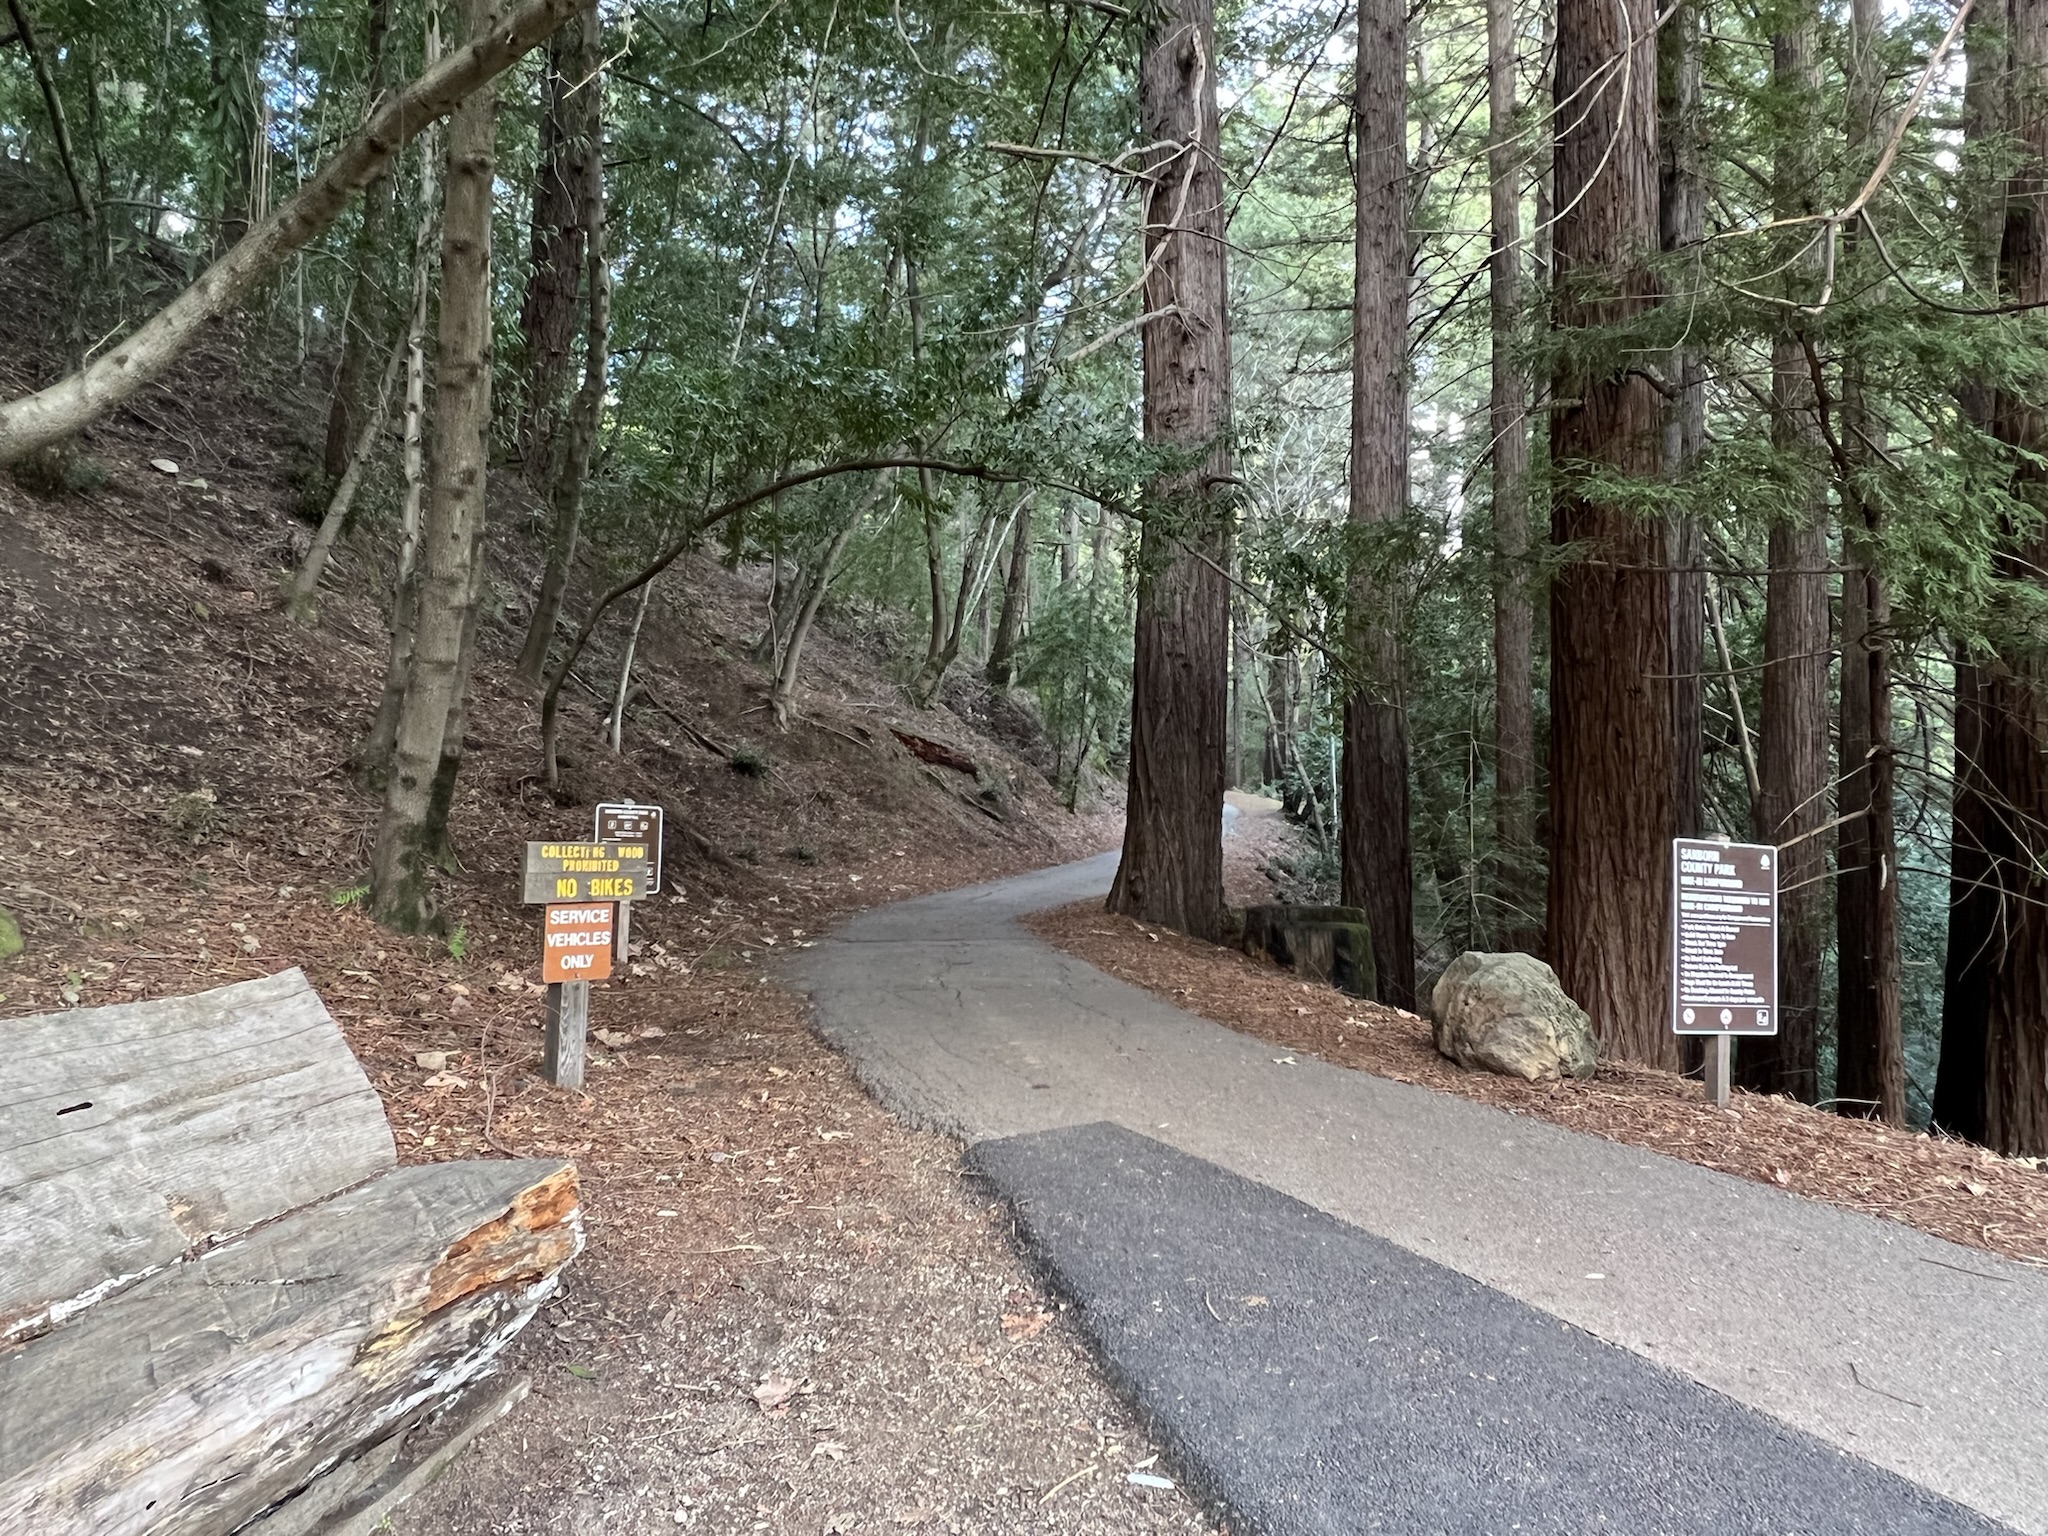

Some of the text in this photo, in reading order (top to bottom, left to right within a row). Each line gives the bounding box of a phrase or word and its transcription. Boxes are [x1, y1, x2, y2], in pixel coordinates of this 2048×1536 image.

[541, 845, 644, 859] COLLECTING WOOD
[562, 859, 620, 872] PROHIBITED
[1680, 861, 1737, 877] COUNTY PARK
[556, 878, 633, 898] NO BIKES
[549, 909, 610, 925] SERVICE
[546, 931, 612, 948] VEHICLES
[560, 954, 595, 970] ONLY
